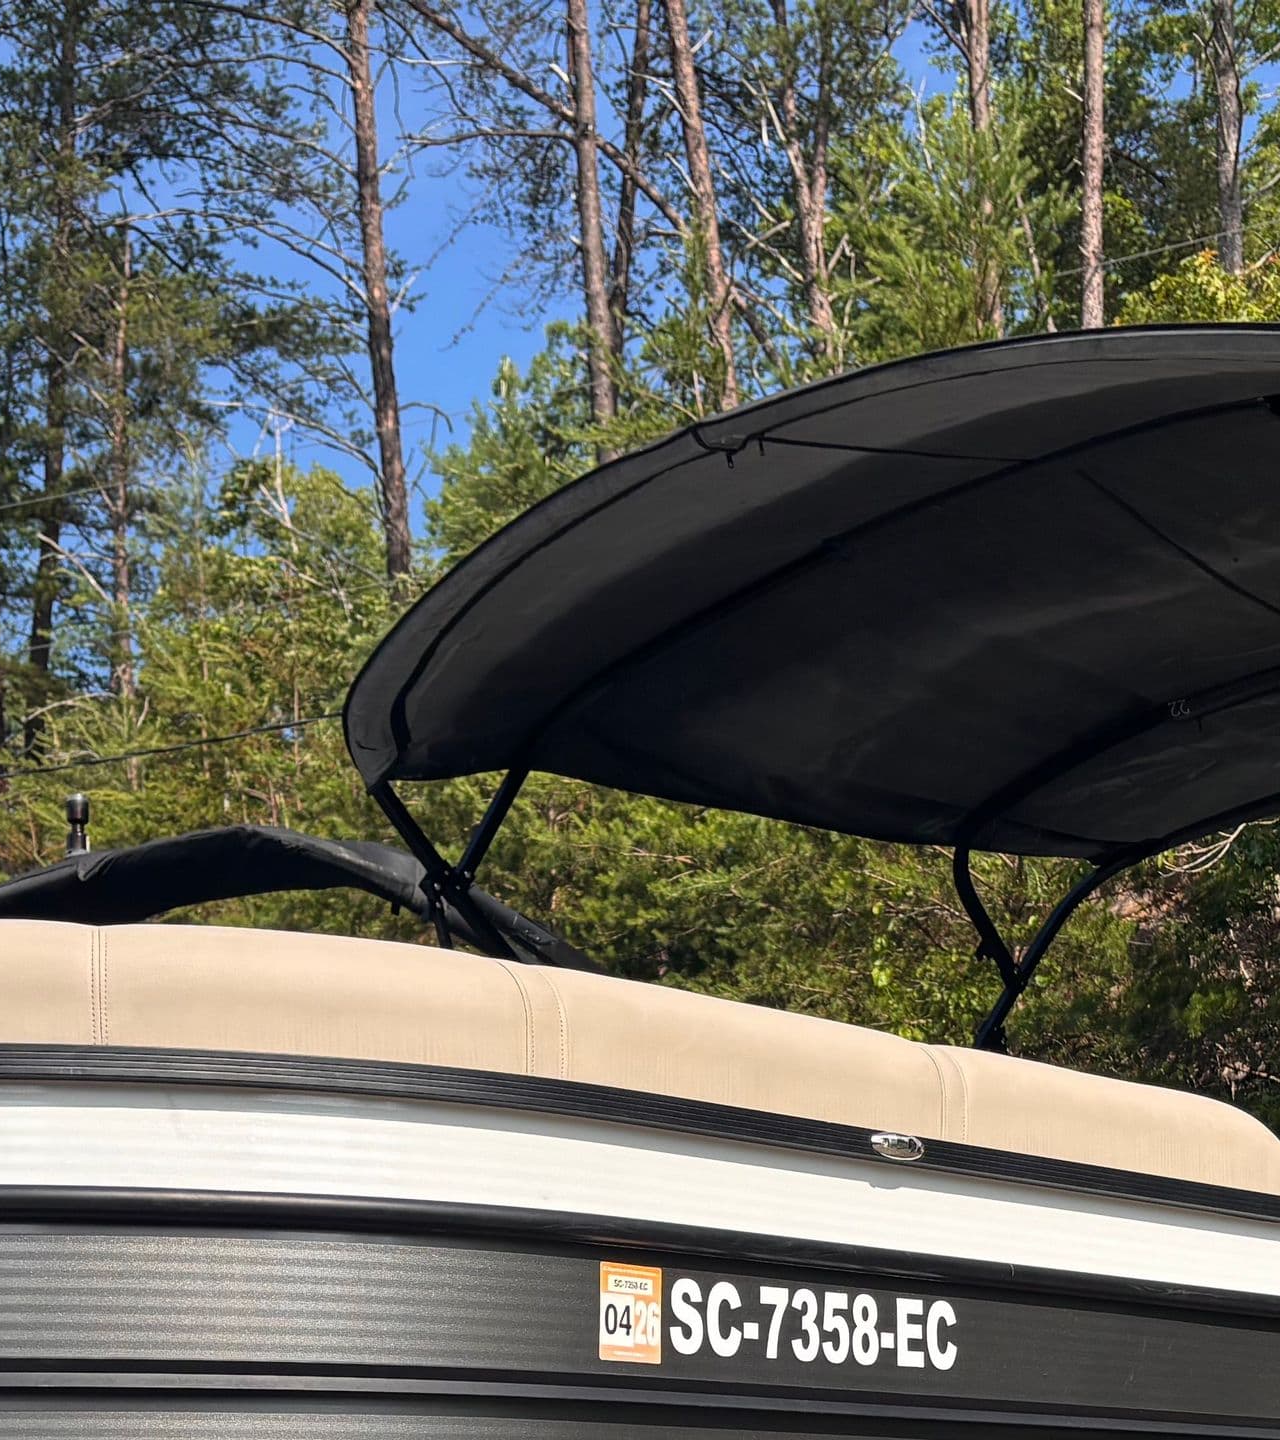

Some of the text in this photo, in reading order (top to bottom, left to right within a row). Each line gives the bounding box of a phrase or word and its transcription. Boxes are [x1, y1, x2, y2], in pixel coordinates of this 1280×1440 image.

[604, 1300, 660, 1346] 04 26
[668, 1277, 959, 1371] SC-7358-EC
